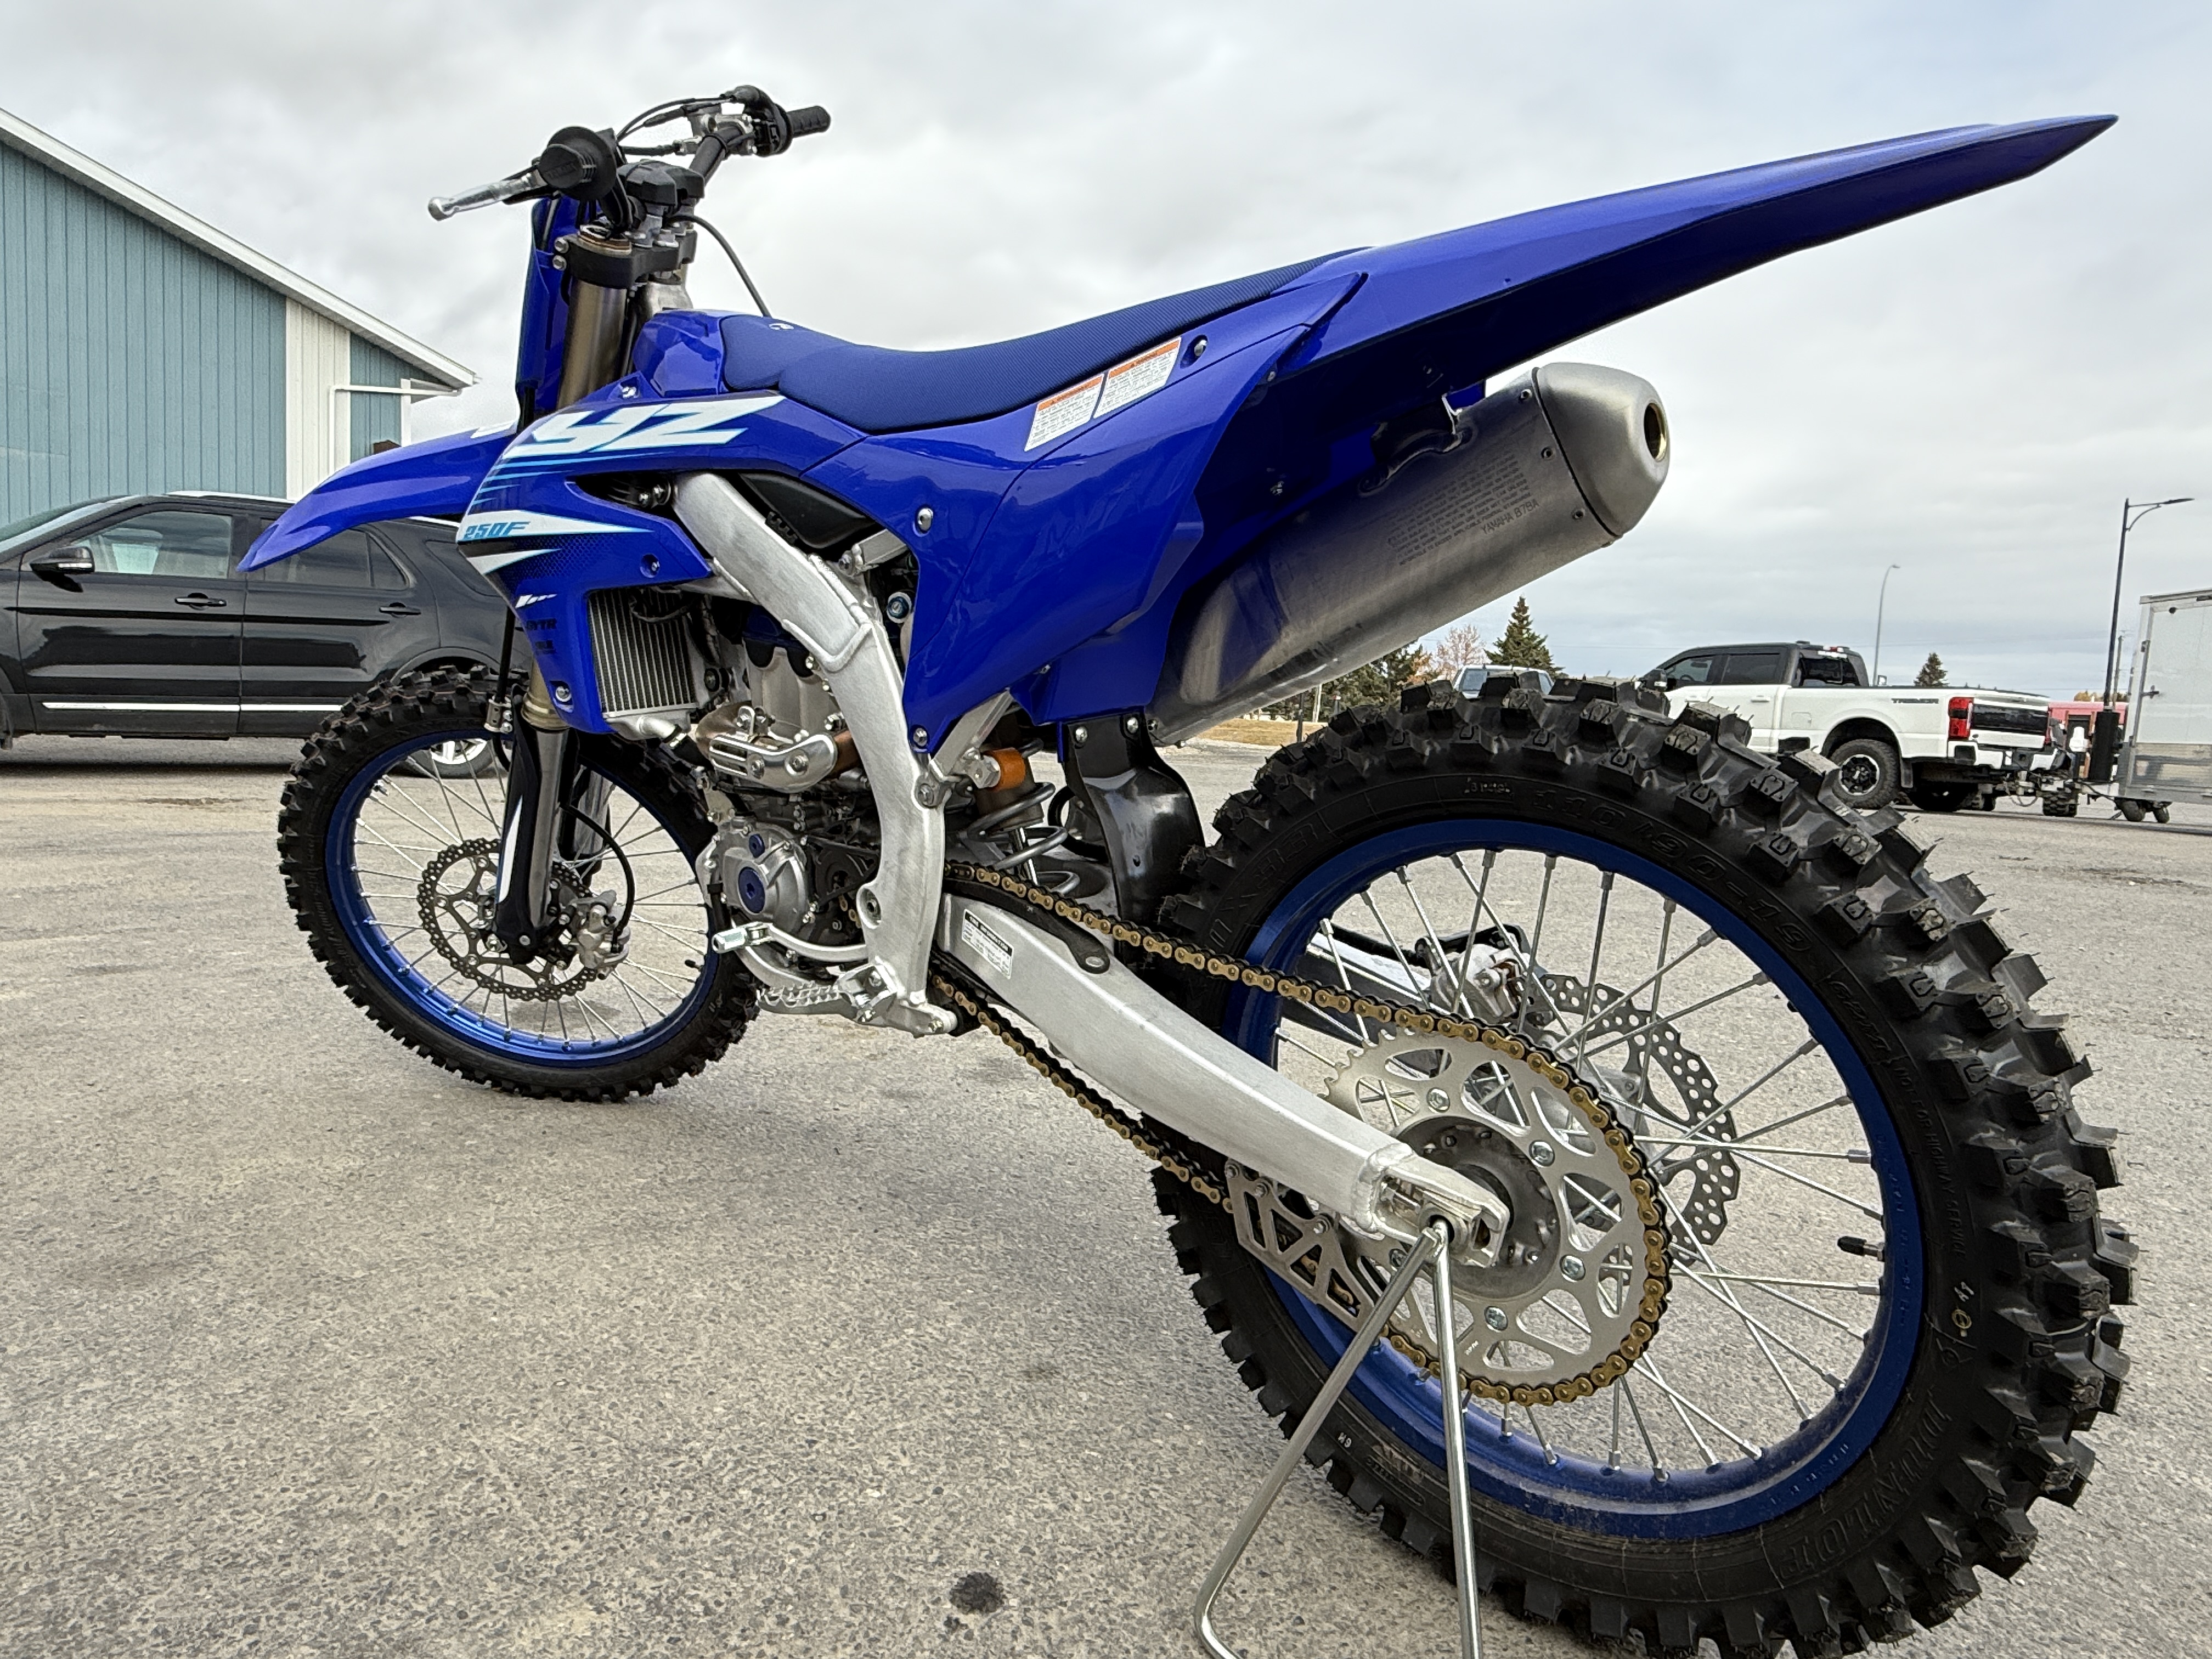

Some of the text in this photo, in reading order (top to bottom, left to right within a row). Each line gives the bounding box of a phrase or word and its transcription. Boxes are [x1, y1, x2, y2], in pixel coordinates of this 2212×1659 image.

[501, 395, 785, 460] YZ
[463, 520, 532, 540] 250F
[1481, 512, 1514, 534] YAMAHA
[1911, 1097, 1933, 1130] FOR
[1924, 1132, 1956, 1200] HIGHWAY
